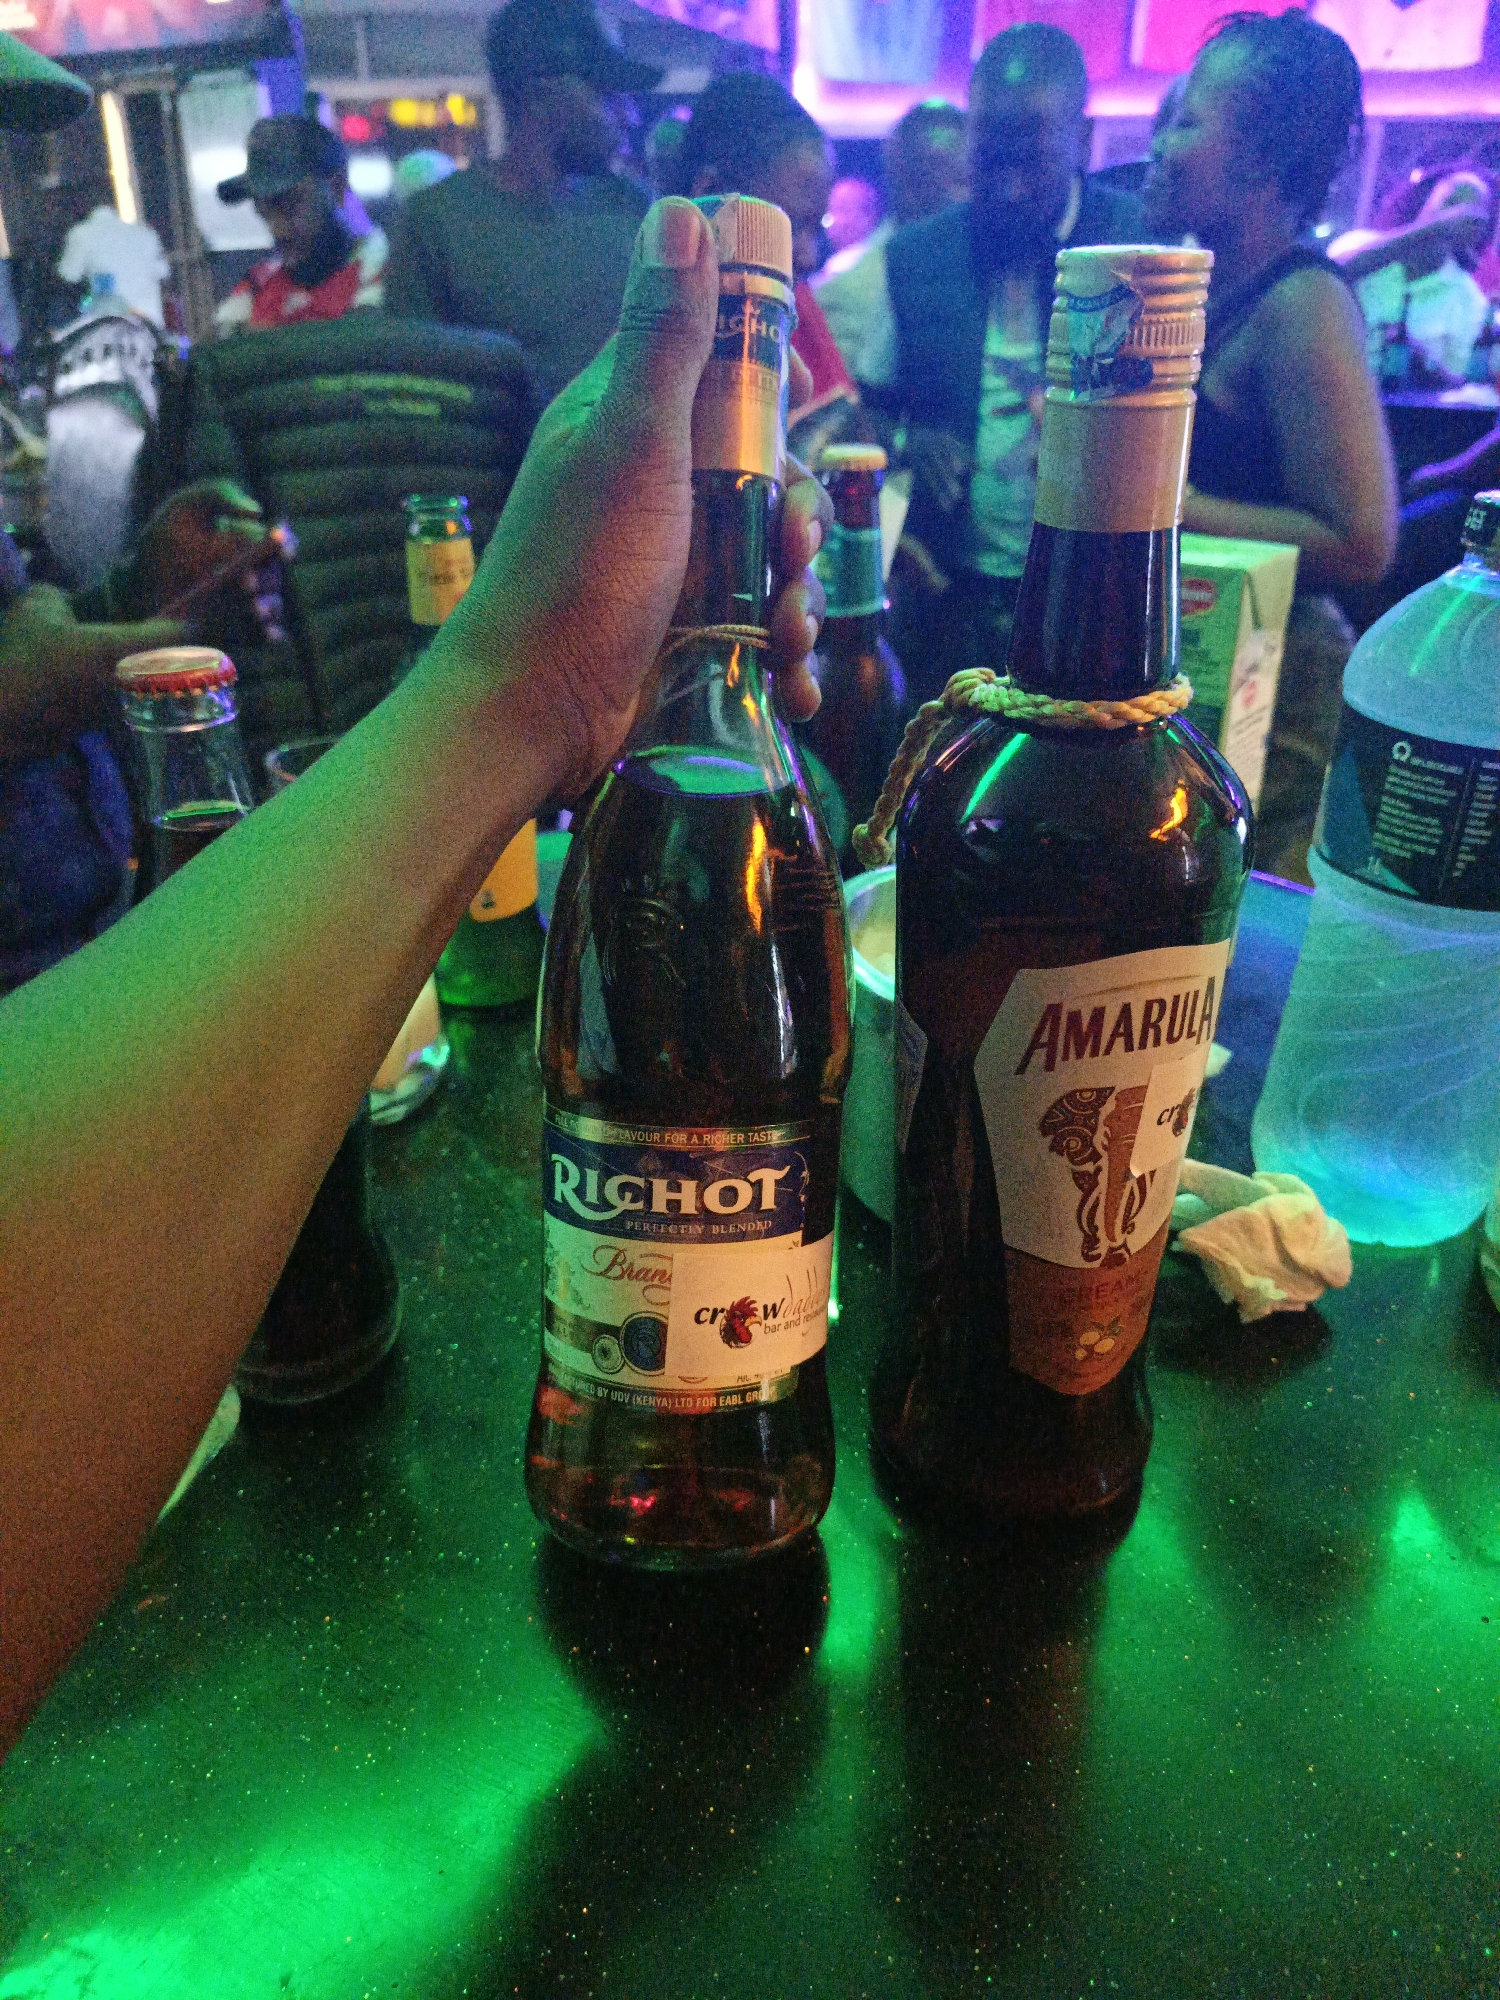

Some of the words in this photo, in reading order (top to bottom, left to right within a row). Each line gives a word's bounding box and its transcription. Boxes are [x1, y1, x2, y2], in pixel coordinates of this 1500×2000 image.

[1014, 976, 1216, 1075] AMARULA
[664, 1132, 688, 1144] FOR
[691, 1133, 699, 1144] A
[703, 1132, 745, 1144] RICHER
[551, 1152, 792, 1221] RICHOT
[625, 1220, 704, 1235] PERFECTLY
[712, 1219, 772, 1235] BLENDED
[763, 1321, 781, 1335] bar
[784, 1316, 801, 1331] and
[597, 1386, 609, 1398] BY
[611, 1389, 630, 1403] UDV
[632, 1394, 672, 1409] (KENYA)
[675, 1396, 693, 1408] LTD
[696, 1395, 717, 1407] FOR
[720, 1393, 743, 1407] EABL
